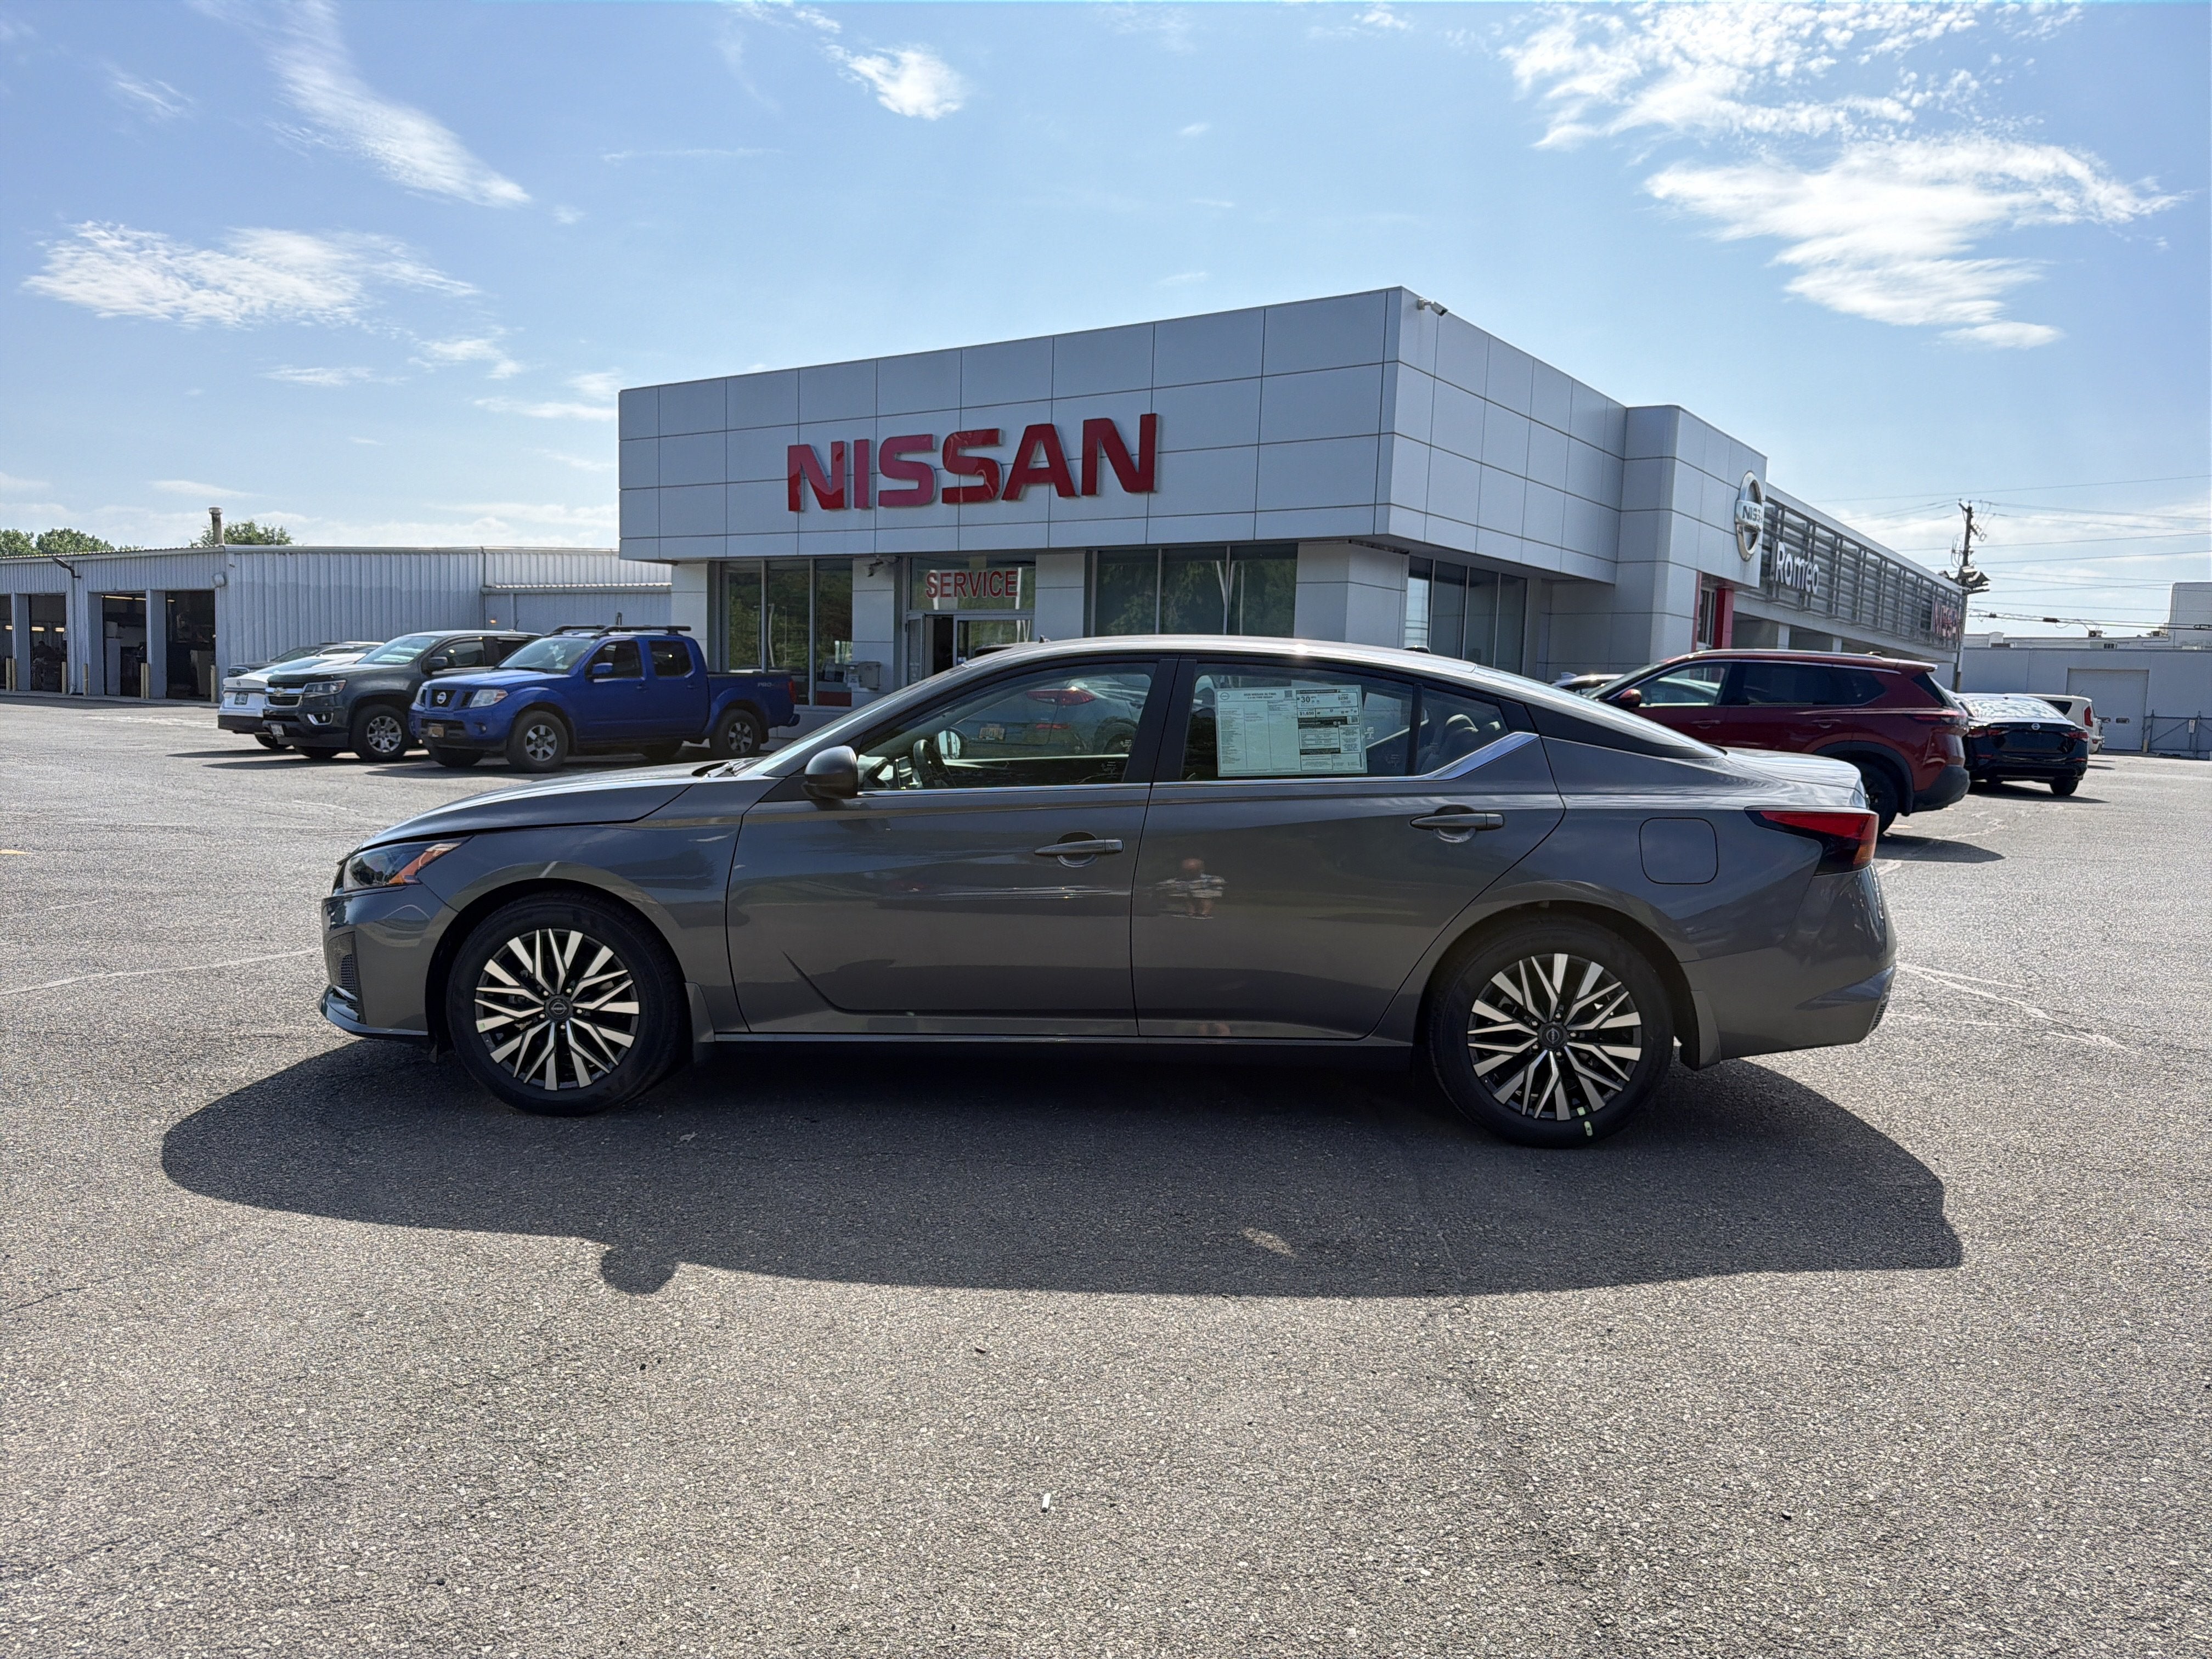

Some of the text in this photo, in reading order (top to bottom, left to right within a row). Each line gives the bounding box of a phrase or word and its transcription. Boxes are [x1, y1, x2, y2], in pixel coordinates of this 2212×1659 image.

[787, 413, 1159, 512] NISSAN
[1742, 505, 1763, 523] NISS
[926, 571, 1018, 599] SERVICE
[1775, 541, 1819, 595] Romeo
